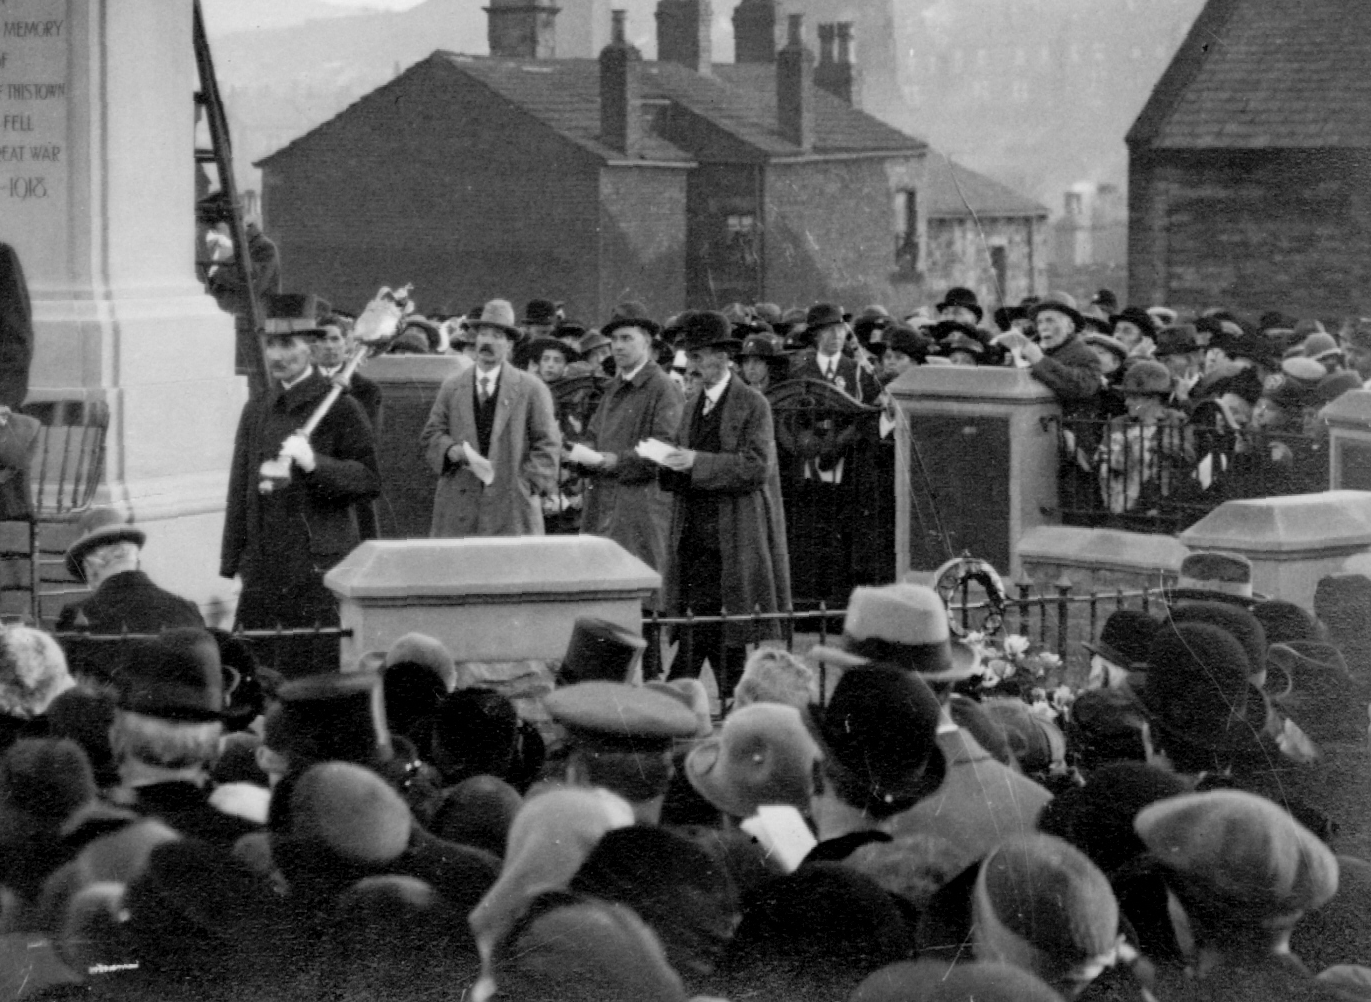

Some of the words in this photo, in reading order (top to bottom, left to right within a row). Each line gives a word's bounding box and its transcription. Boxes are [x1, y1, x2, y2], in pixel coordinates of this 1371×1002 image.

[3, 20, 63, 38] MEMORY
[8, 83, 33, 100] THIS
[34, 83, 66, 100] TOWN
[3, 115, 34, 131] FELL
[30, 146, 61, 162] WAR
